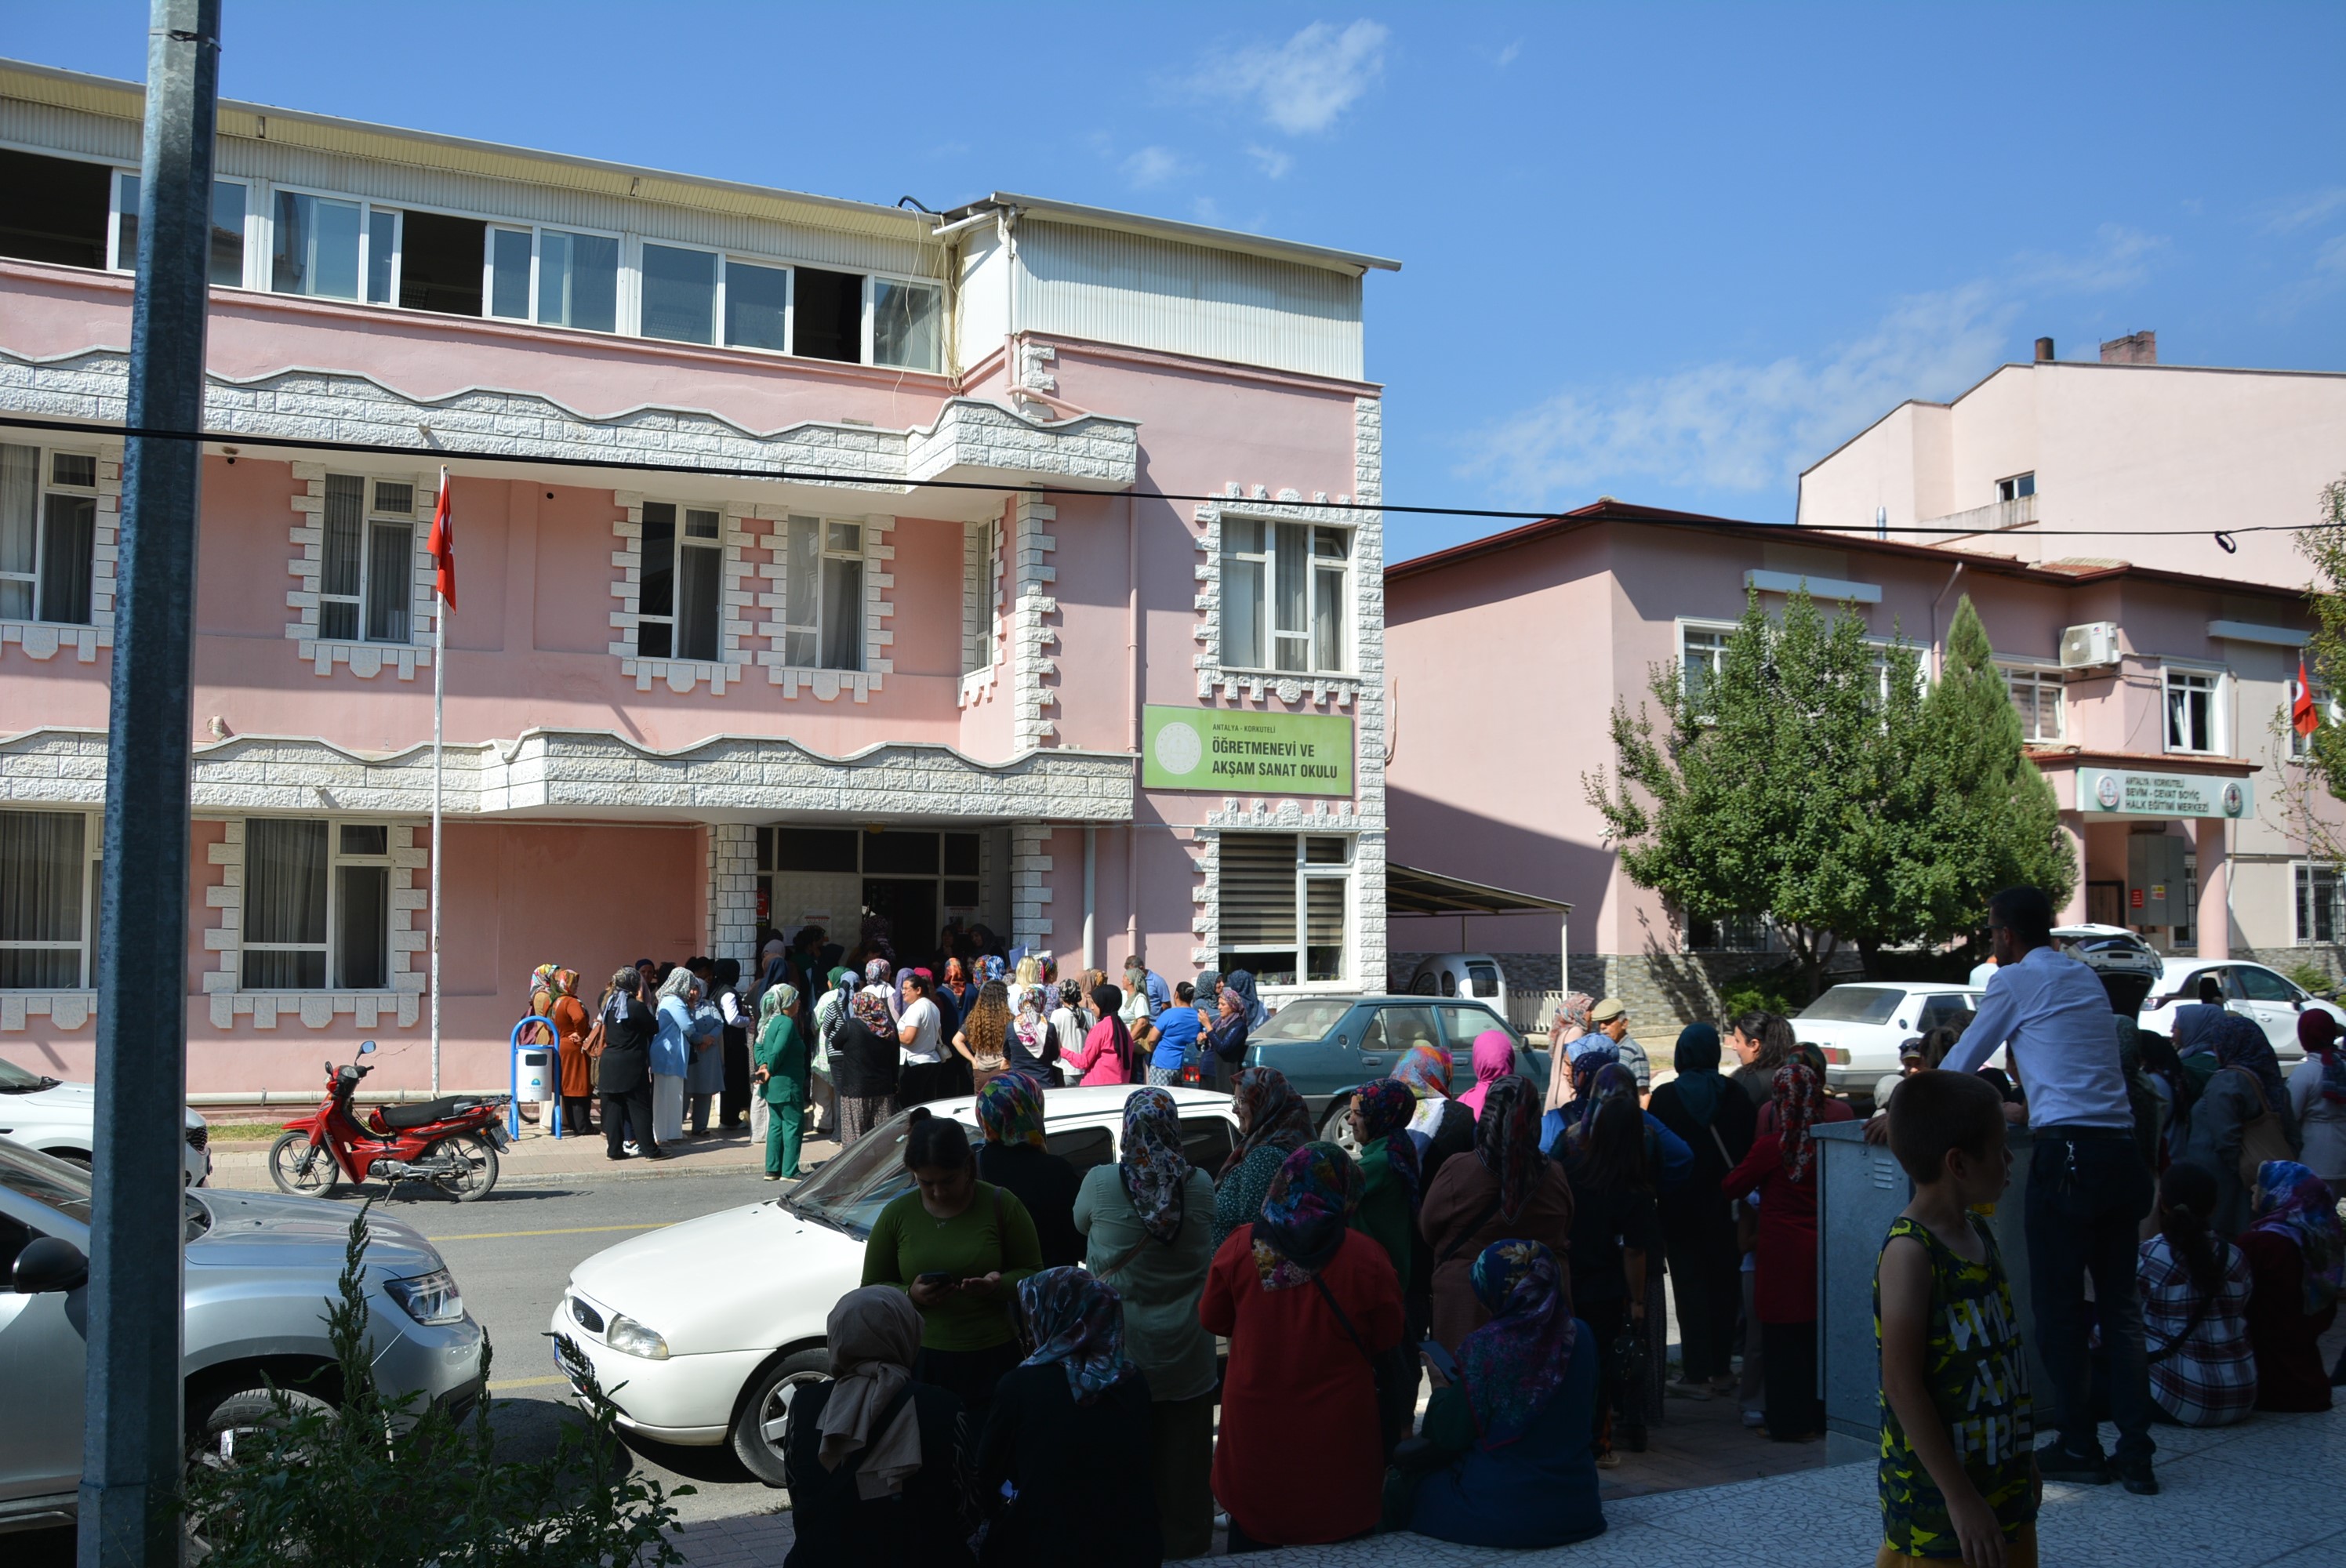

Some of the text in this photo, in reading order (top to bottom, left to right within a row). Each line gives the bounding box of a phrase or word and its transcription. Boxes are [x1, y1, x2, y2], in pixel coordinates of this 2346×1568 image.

[1212, 724, 1239, 732] ANTALYA
[1244, 725, 1276, 734] KORKUTELİ
[1212, 736, 1315, 757] ÖĞRETMENEVİ VE
[1212, 760, 1338, 779] AKŞAM SANAT OKULU
[2154, 789, 2177, 798] CEVAT
[2126, 800, 2209, 812] HALK EĞİTİMİ MERKEZİ
